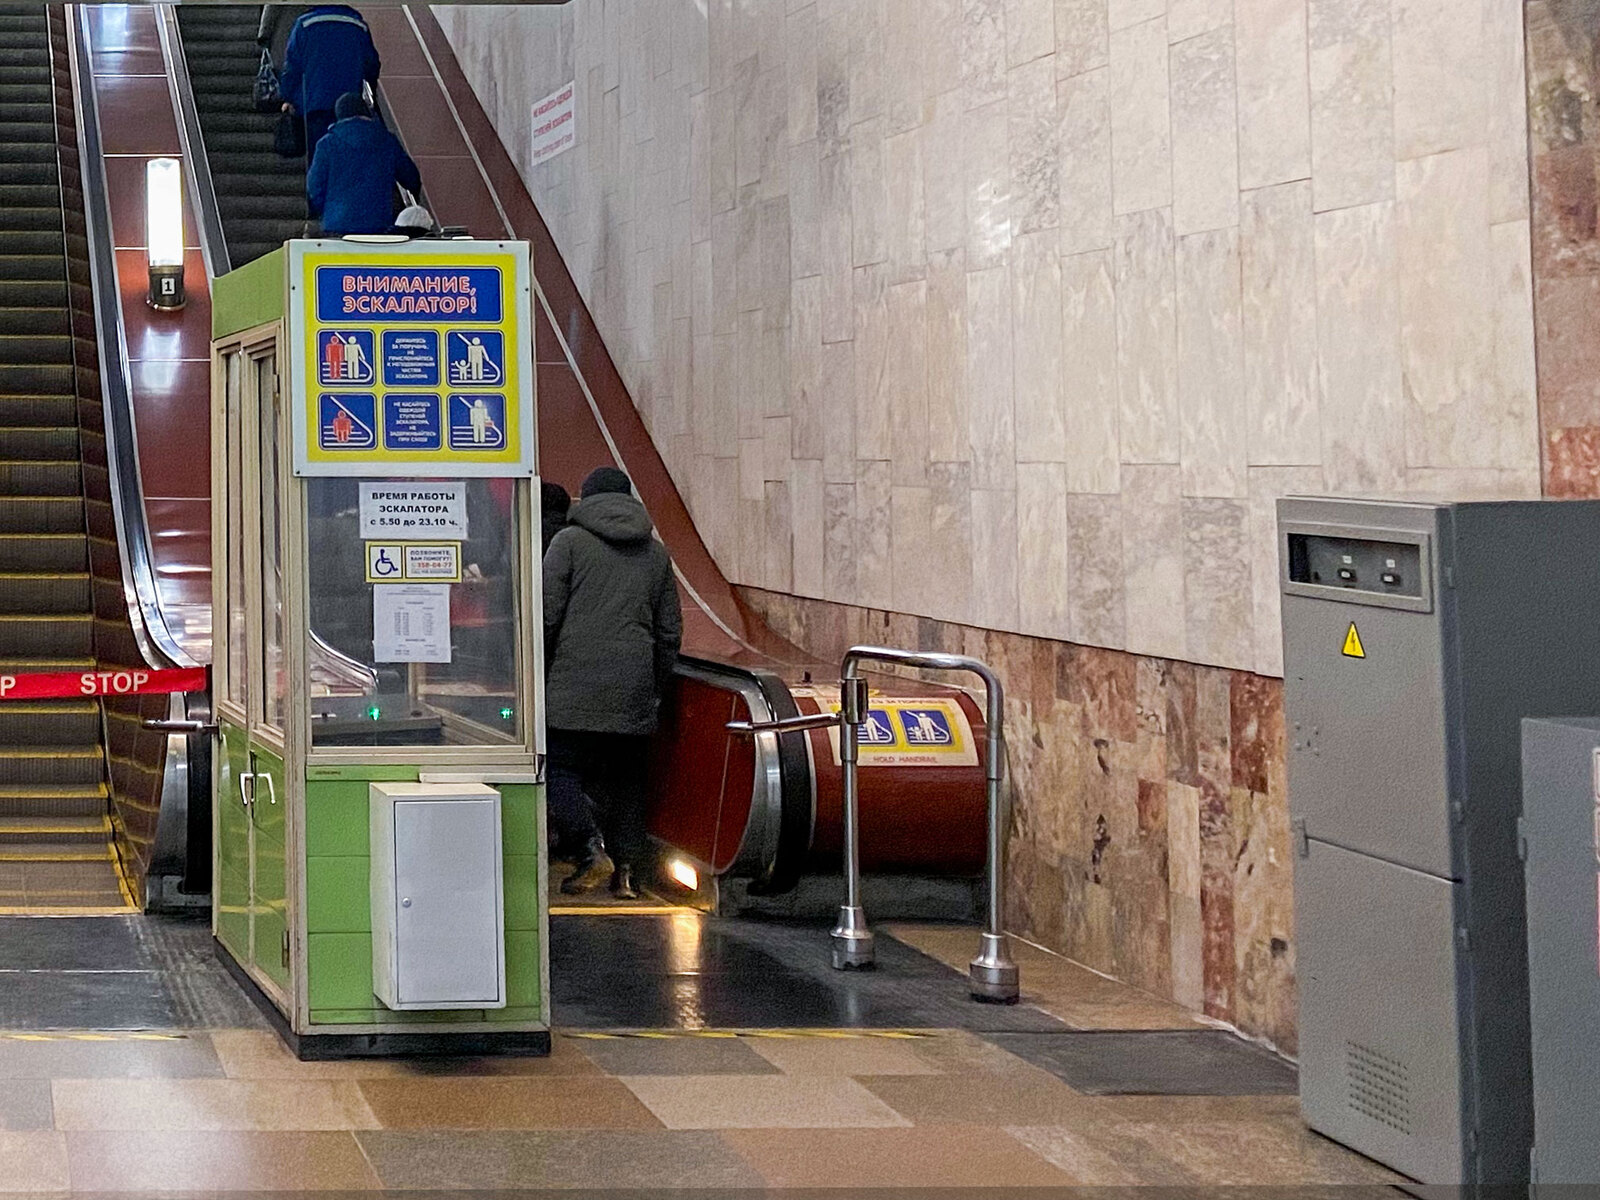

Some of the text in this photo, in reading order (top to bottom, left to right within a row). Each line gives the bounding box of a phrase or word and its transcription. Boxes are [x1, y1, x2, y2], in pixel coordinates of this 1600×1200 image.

[164, 280, 172, 292] 1
[343, 275, 477, 296] ВНИМАНИЕ,
[343, 296, 477, 314] ЭСКАЛАТОР!
[372, 492, 455, 501] ВРЕМЯ РАБОТЫ
[379, 505, 449, 513] ЭСКАЛАТОРА
[380, 518, 401, 526] 5.50
[403, 519, 416, 527] до
[418, 518, 446, 526] 23.10
[80, 672, 149, 695] STOP
